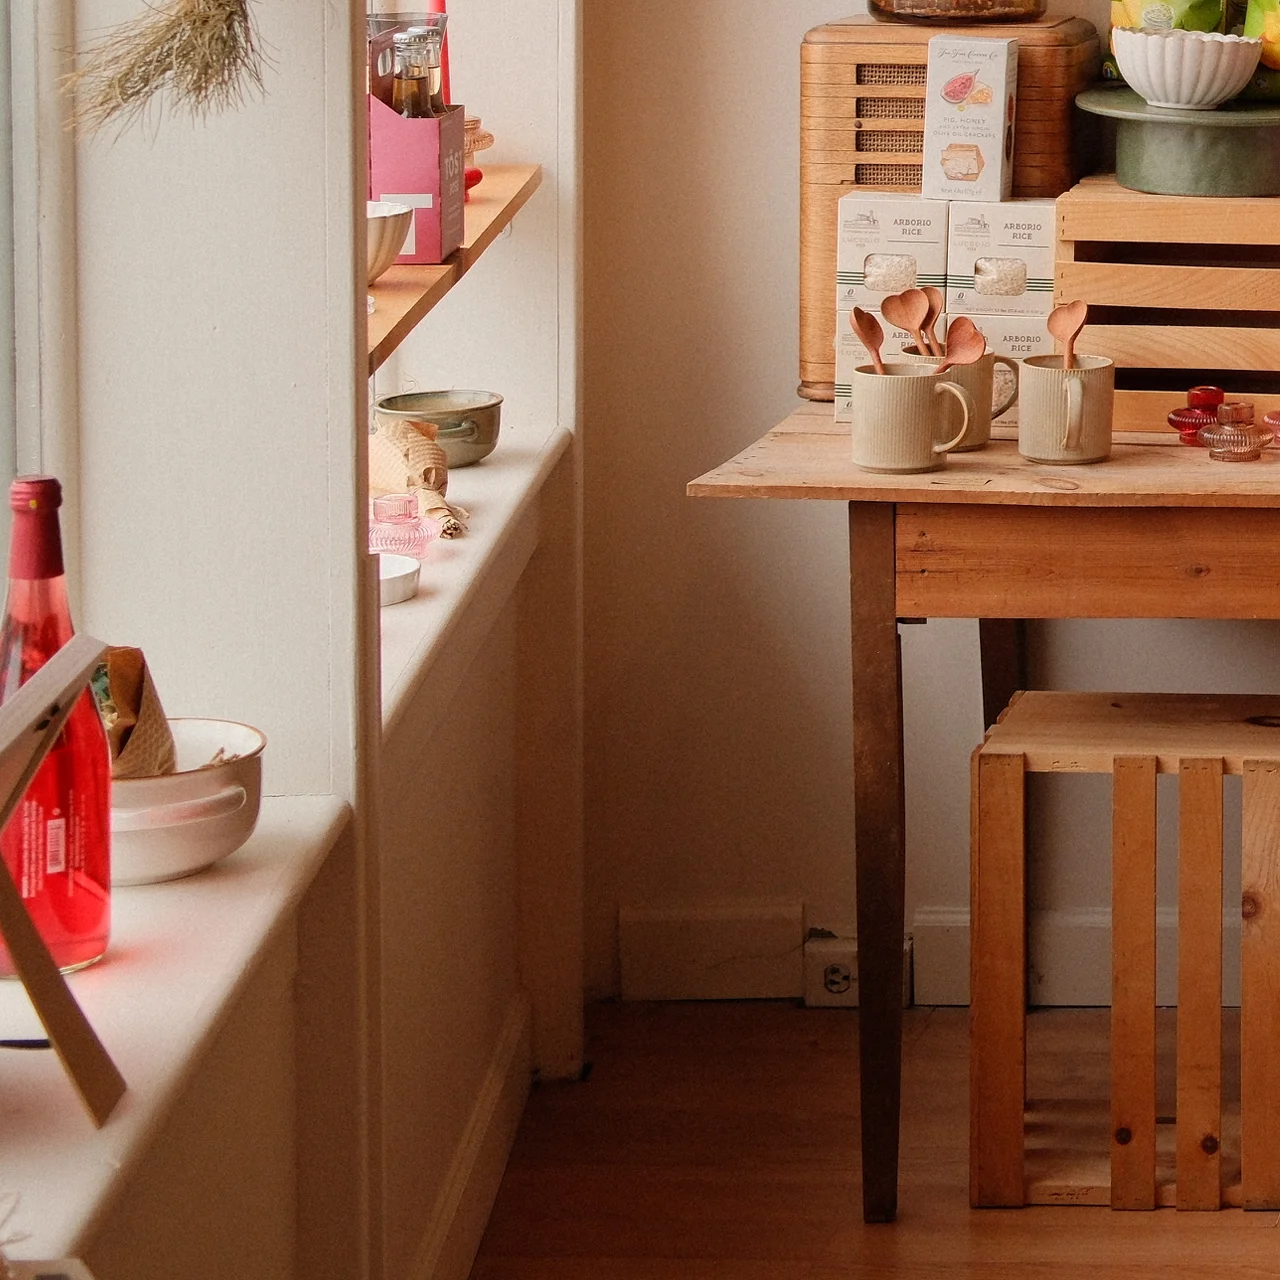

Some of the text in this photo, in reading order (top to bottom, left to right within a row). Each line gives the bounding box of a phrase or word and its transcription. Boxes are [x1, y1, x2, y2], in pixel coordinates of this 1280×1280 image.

[444, 149, 463, 181] TÖST
[893, 219, 932, 227] ARBORIO
[1004, 223, 1042, 231] ARBORIO
[901, 228, 922, 236] RICE
[1002, 335, 1041, 343] ARBORIO
[1011, 344, 1032, 352] RICE
